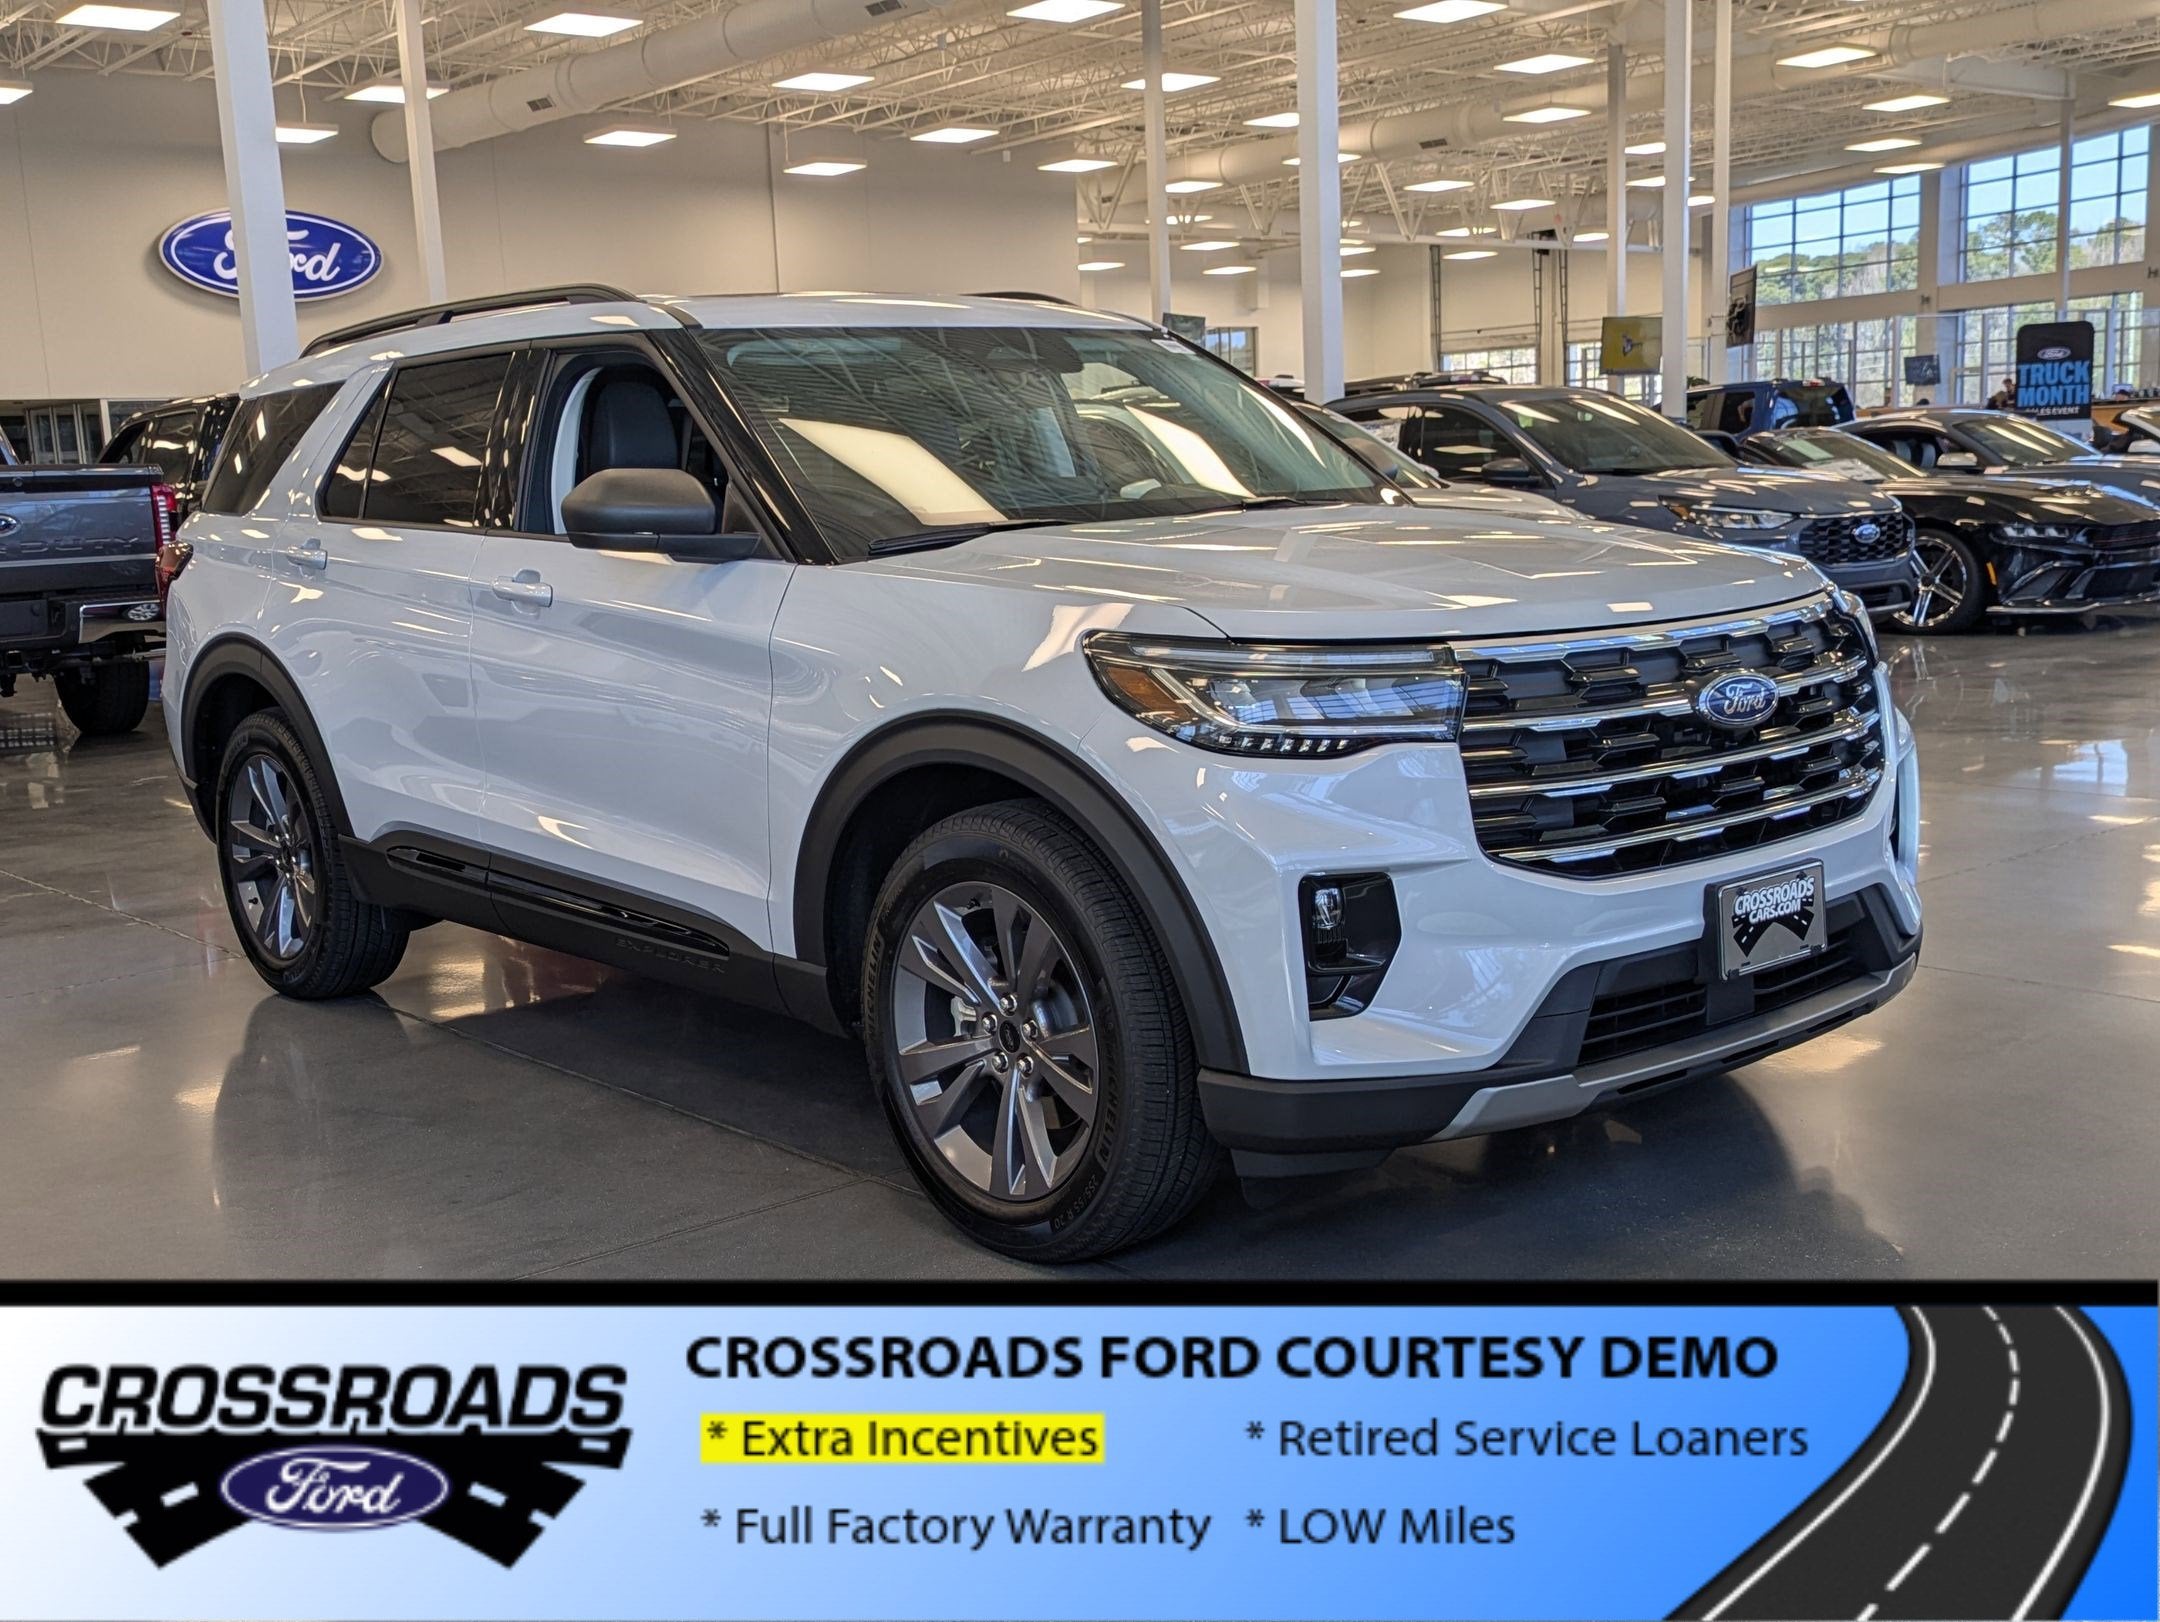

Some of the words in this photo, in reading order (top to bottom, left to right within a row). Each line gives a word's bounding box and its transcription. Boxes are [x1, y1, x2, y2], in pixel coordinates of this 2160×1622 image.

[213, 230, 341, 281] rd
[2018, 361, 2090, 386] TRUCK
[2017, 384, 2089, 408] MONTH
[2052, 405, 2080, 415] EVENT
[20, 537, 139, 554] DUTY
[1724, 681, 1766, 715] Ford
[1734, 876, 1815, 916] CROSSROADS
[1749, 899, 1801, 924] CARS.COM
